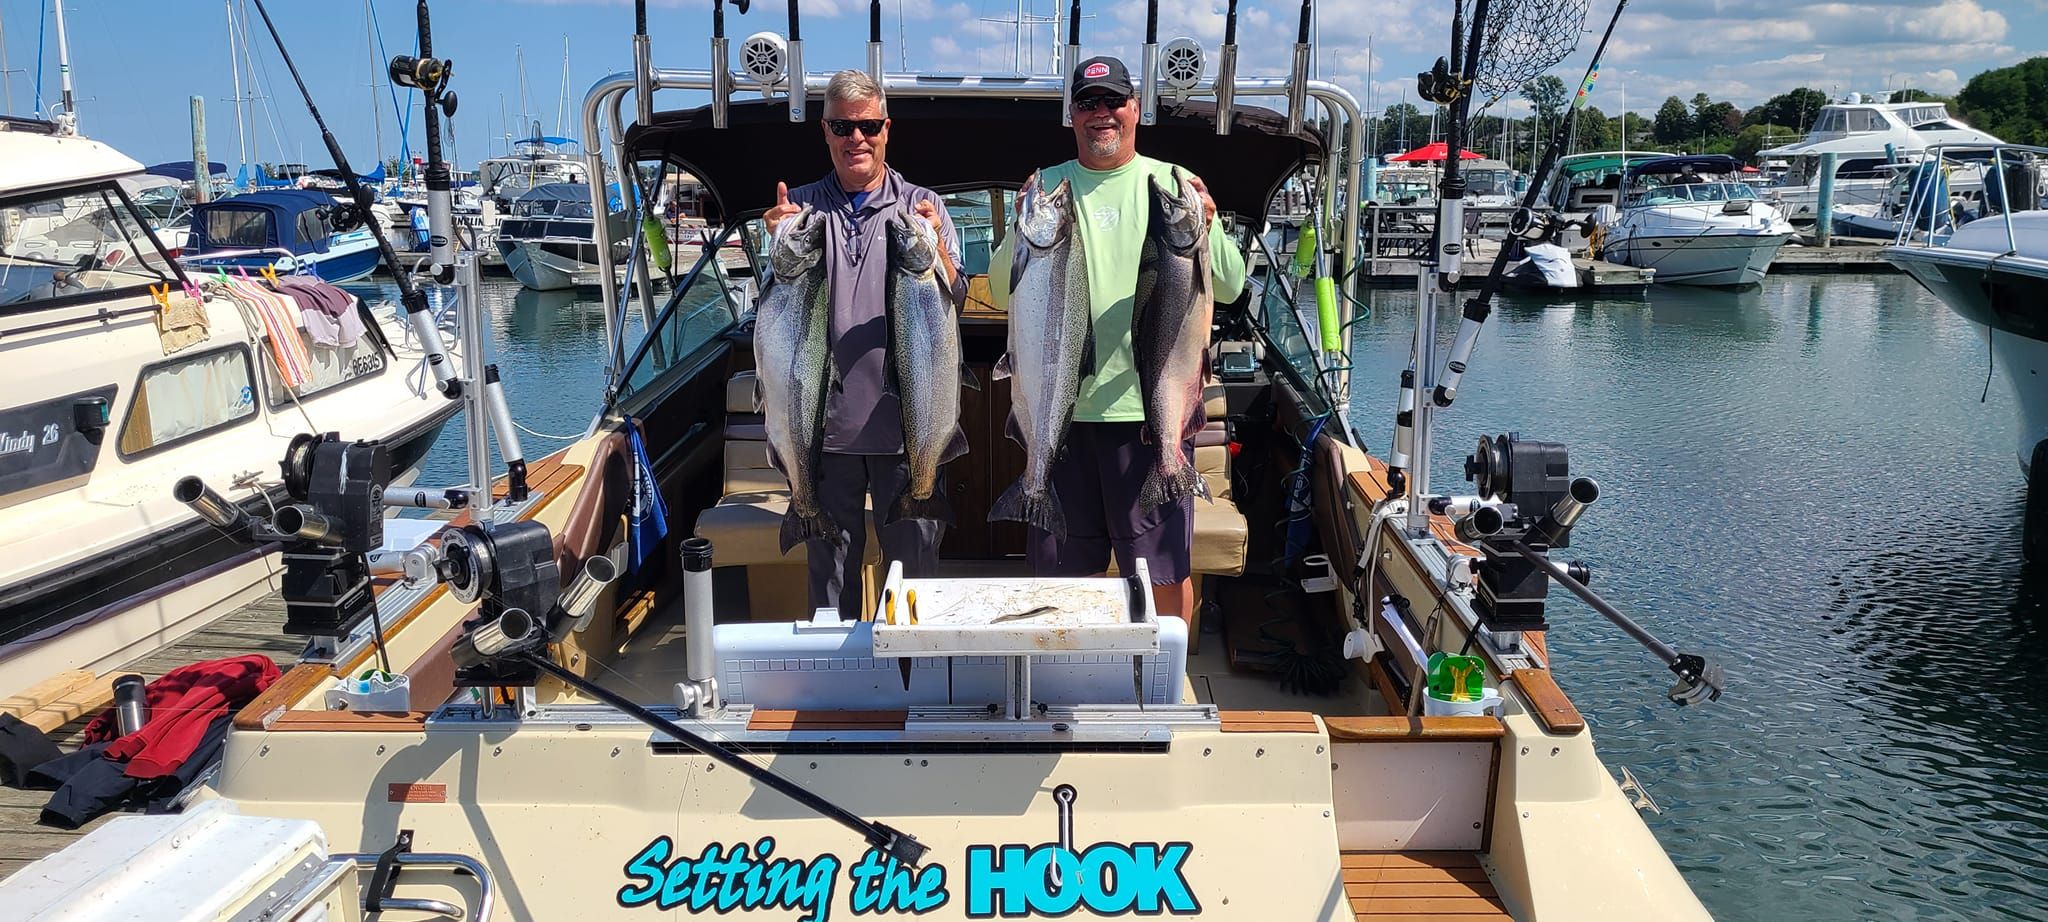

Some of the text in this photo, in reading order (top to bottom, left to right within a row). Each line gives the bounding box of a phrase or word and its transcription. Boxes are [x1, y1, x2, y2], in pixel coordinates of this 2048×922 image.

[1086, 66, 1108, 75] PENN
[42, 423, 59, 445] 26
[619, 837, 1200, 922] Setting the HOOK
